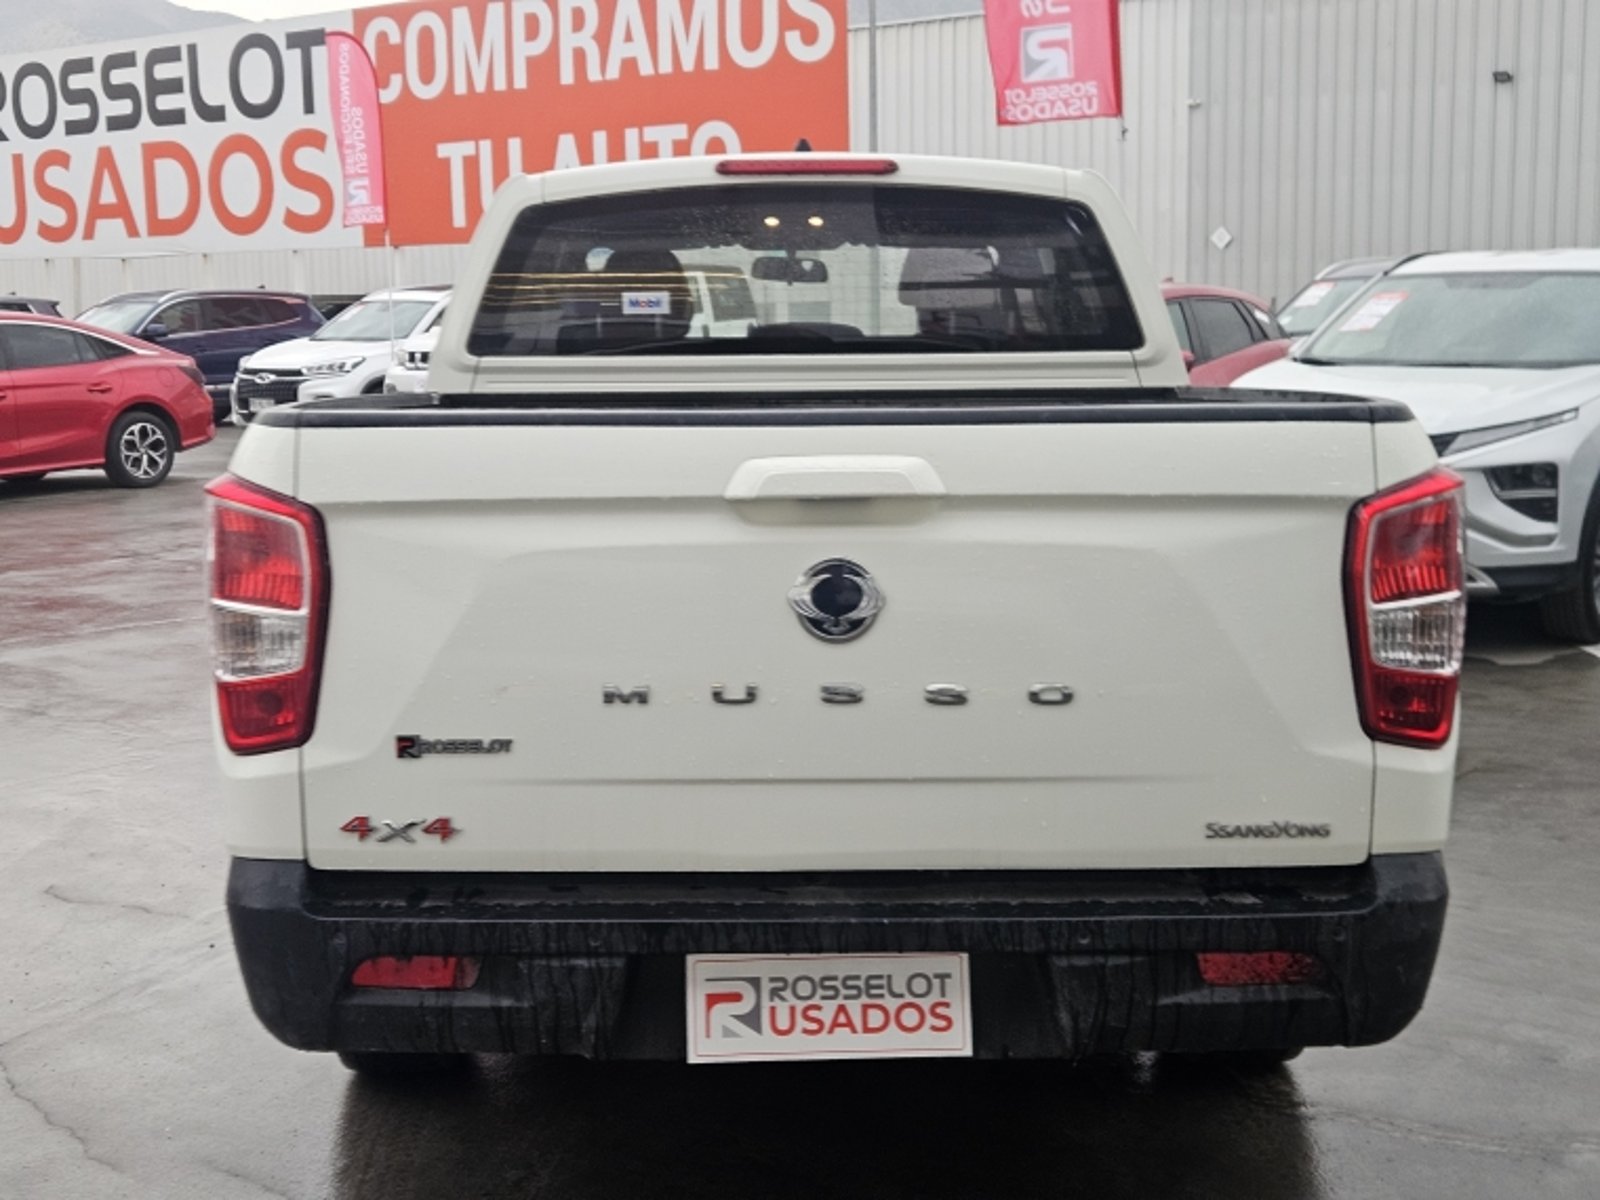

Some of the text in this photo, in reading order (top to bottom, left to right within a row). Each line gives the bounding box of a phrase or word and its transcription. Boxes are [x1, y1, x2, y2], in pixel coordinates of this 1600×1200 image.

[364, 0, 836, 104] COMPRAMOS
[0, 28, 326, 142] OSSELOT
[602, 682, 1075, 706] MUSSO
[420, 738, 513, 754] ROSSELOT
[768, 972, 953, 1002] ROSSELOT
[769, 1001, 955, 1036] USADOS
